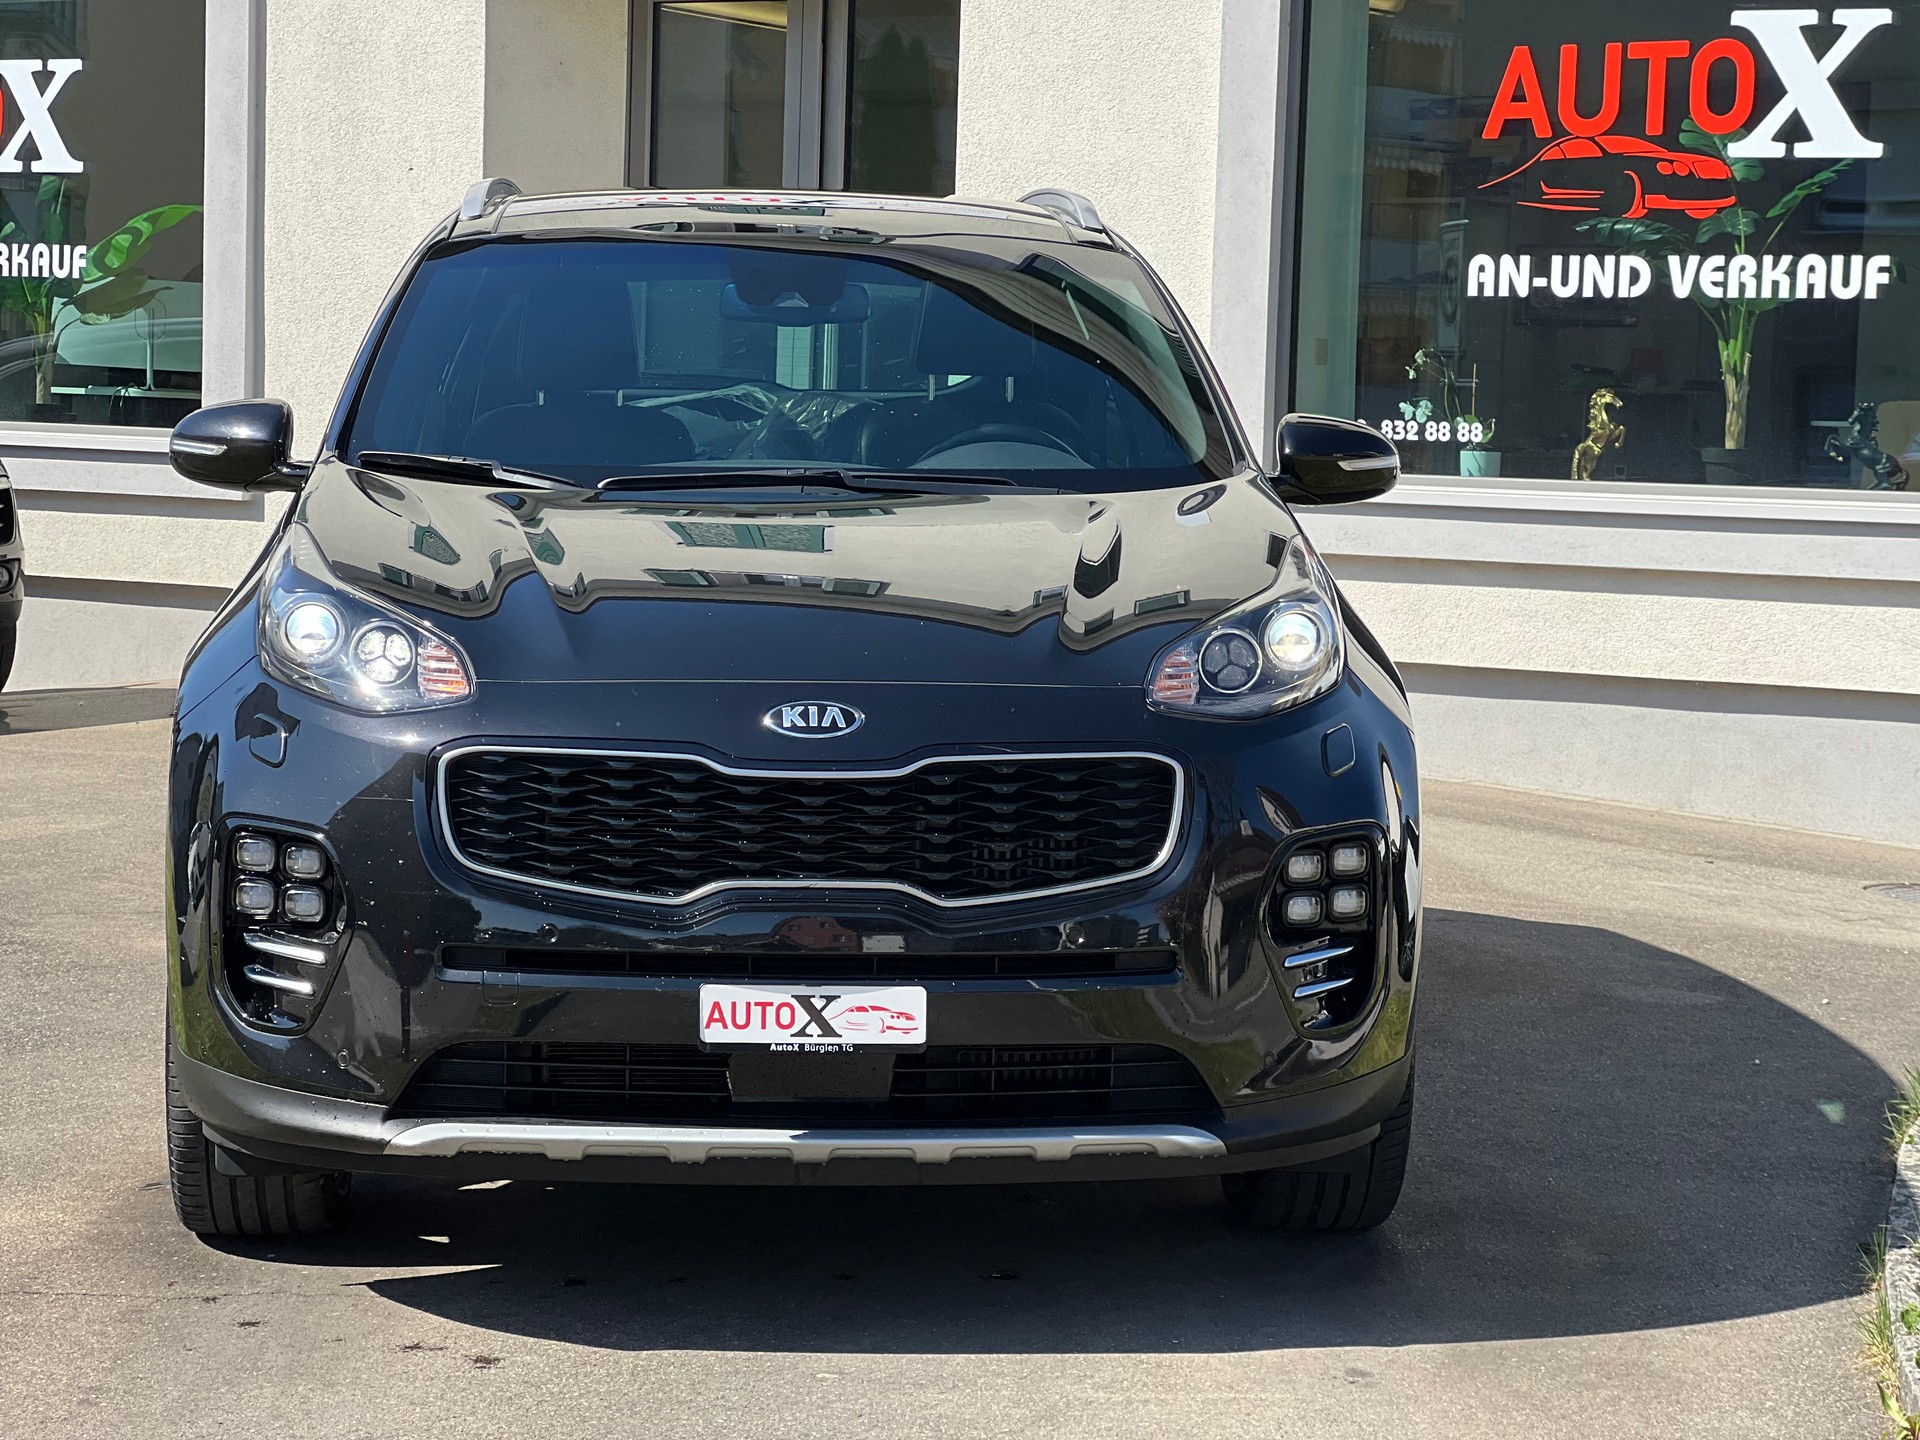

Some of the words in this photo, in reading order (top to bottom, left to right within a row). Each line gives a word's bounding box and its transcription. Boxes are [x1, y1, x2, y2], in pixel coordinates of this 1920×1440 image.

[1467, 253, 1653, 299] AN-UND
[1666, 253, 1892, 300] VERKAUF
[1380, 419, 1419, 441] 832
[1424, 420, 1451, 442] 88
[1456, 421, 1484, 443] 88
[781, 705, 847, 728] KIA
[769, 1043, 800, 1052] AutoX
[804, 1043, 839, 1054] Bürglen
[841, 1043, 854, 1052] TG
